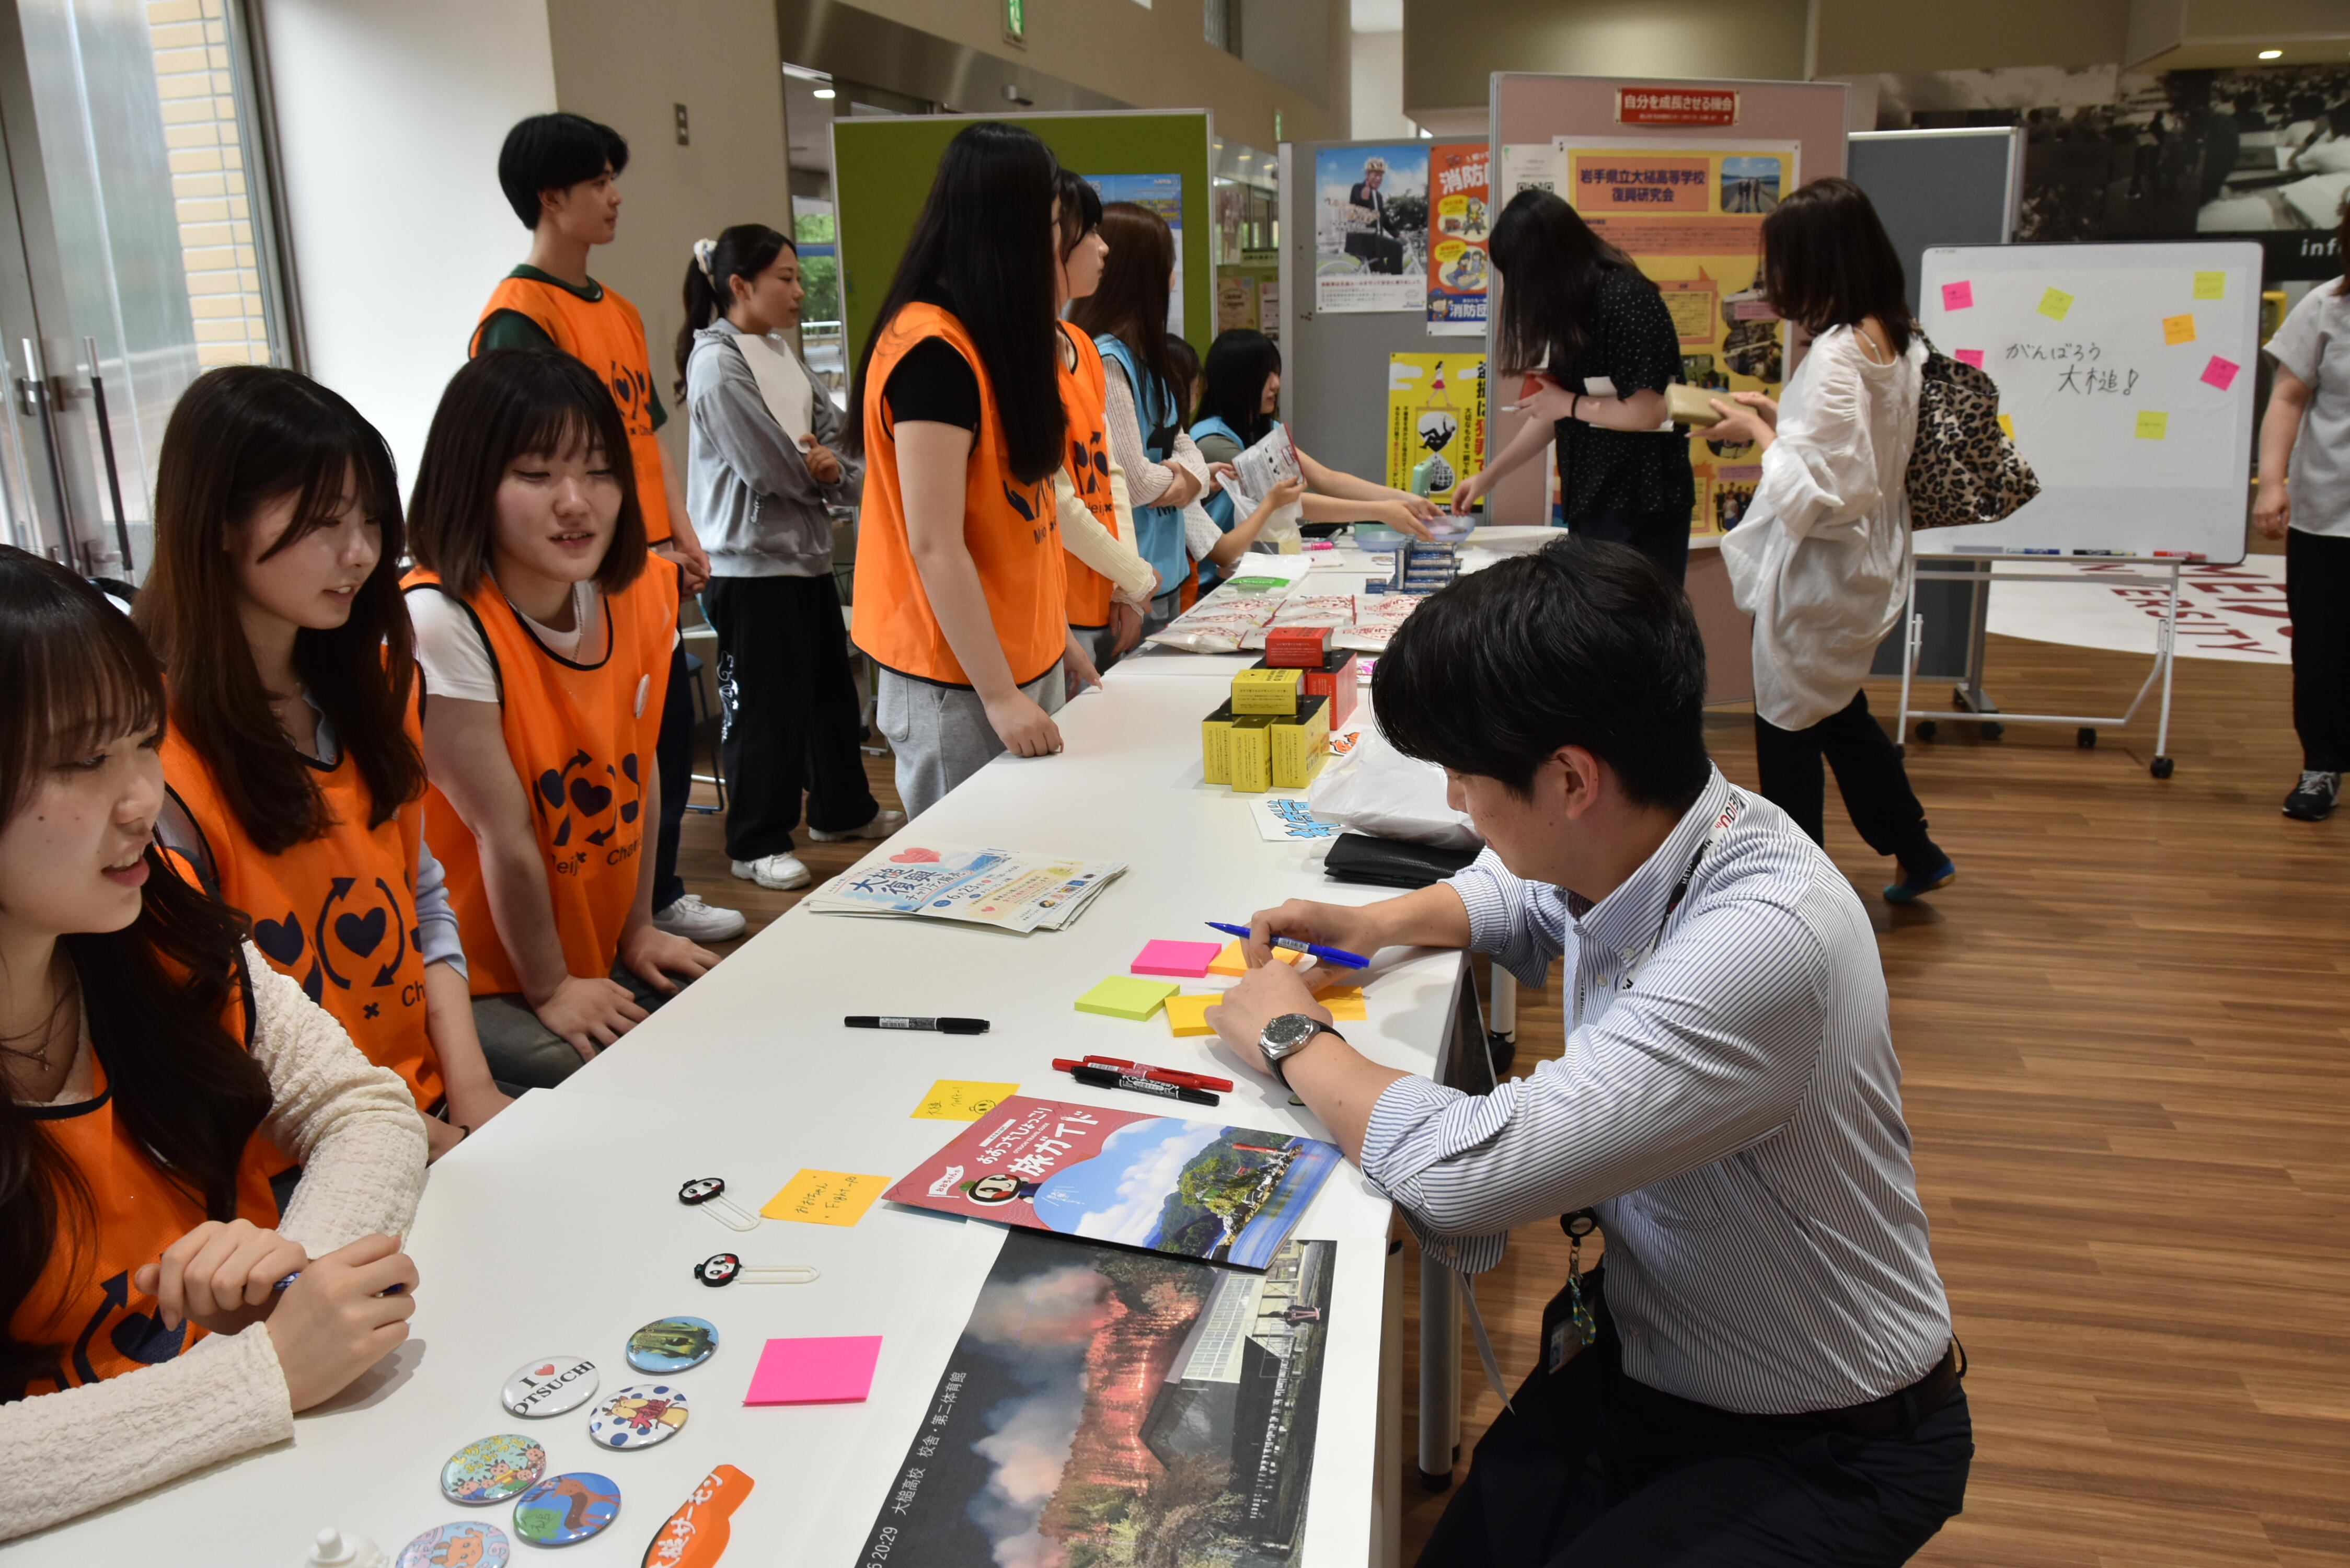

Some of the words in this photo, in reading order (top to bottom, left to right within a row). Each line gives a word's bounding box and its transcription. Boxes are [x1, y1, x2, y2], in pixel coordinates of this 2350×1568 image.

[1624, 95, 1733, 111] 自分を成長させる機会
[1581, 169, 1706, 185] 岩手県立大槌高等学校
[1612, 187, 1674, 202] 復興研究会
[2300, 237, 2342, 256] inf
[2006, 342, 2101, 361] がんばろう
[849, 868, 914, 893] 大槌
[881, 870, 942, 895] 復興
[905, 871, 966, 901] チャリティ販売
[976, 1106, 1053, 1165] おおつちひょっこり
[1007, 1110, 1099, 1177] 旅ガイド
[513, 1360, 597, 1415] OTSUCHI
[916, 1371, 967, 1458] 校舎・第二体育館
[891, 1467, 927, 1516] 大槌高校
[871, 1526, 898, 1561] 20:29
